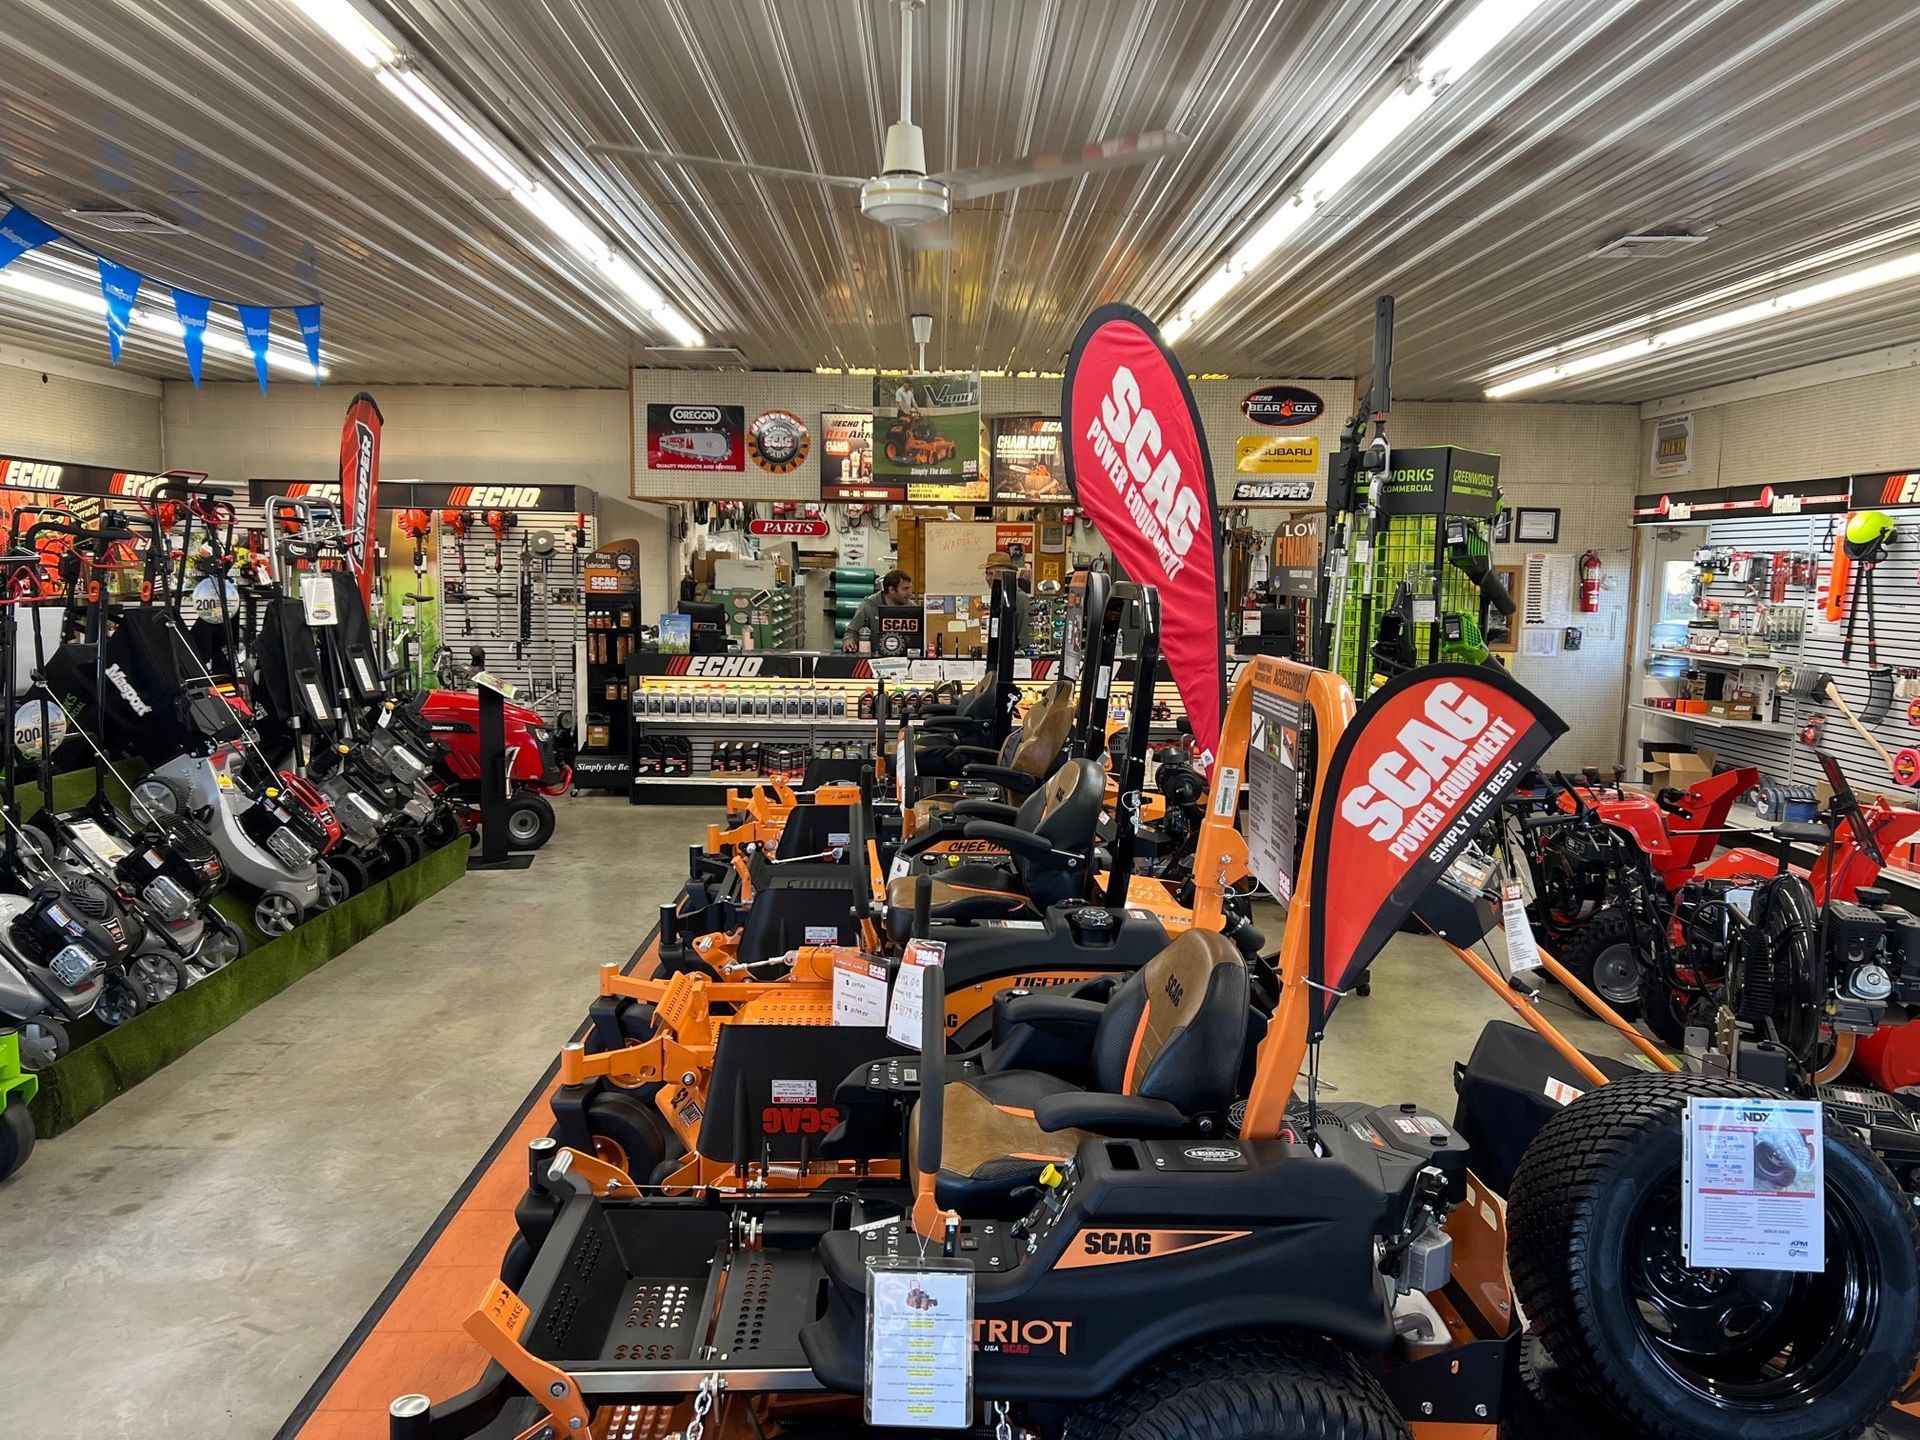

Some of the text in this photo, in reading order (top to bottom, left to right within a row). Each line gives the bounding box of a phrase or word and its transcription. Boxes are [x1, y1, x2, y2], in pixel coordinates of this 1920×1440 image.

[675, 409, 716, 420] OREGON
[1249, 404, 1317, 412] BEAR CAT
[764, 435, 793, 448] SCAG
[997, 434, 1057, 450] CHAIN SAWS
[1101, 365, 1200, 557] SCAG
[5, 459, 63, 490] ECHO
[1453, 468, 1495, 488] GREENWORKS
[353, 433, 374, 561] SNAPPER
[467, 486, 542, 508] ECHO
[1237, 484, 1310, 498] SNAPPER
[1383, 484, 1433, 493] COMMERCIAL
[1086, 416, 1185, 582] POWER EQUIPMENT
[763, 521, 815, 534] PARTS
[591, 576, 618, 586] SCAG
[196, 598, 215, 612] 200
[883, 619, 917, 631] SCAG
[686, 656, 764, 676] ECHO
[105, 662, 153, 717] Masport
[16, 727, 42, 744] 200
[577, 763, 604, 773] Simply
[1341, 681, 1488, 842] SCAG
[1388, 716, 1517, 863] POWER EQUIPMENT
[1429, 759, 1523, 864] SIMPLY THE BEST.
[916, 948, 940, 962] SCAG
[868, 962, 887, 976] SCAG
[1164, 974, 1184, 1008] SCAG
[1084, 1231, 1151, 1255] SCAG
[505, 1301, 524, 1332] BRAKE
[972, 1319, 1073, 1356] TRIOT
[984, 1344, 1030, 1354] USA SCAG
